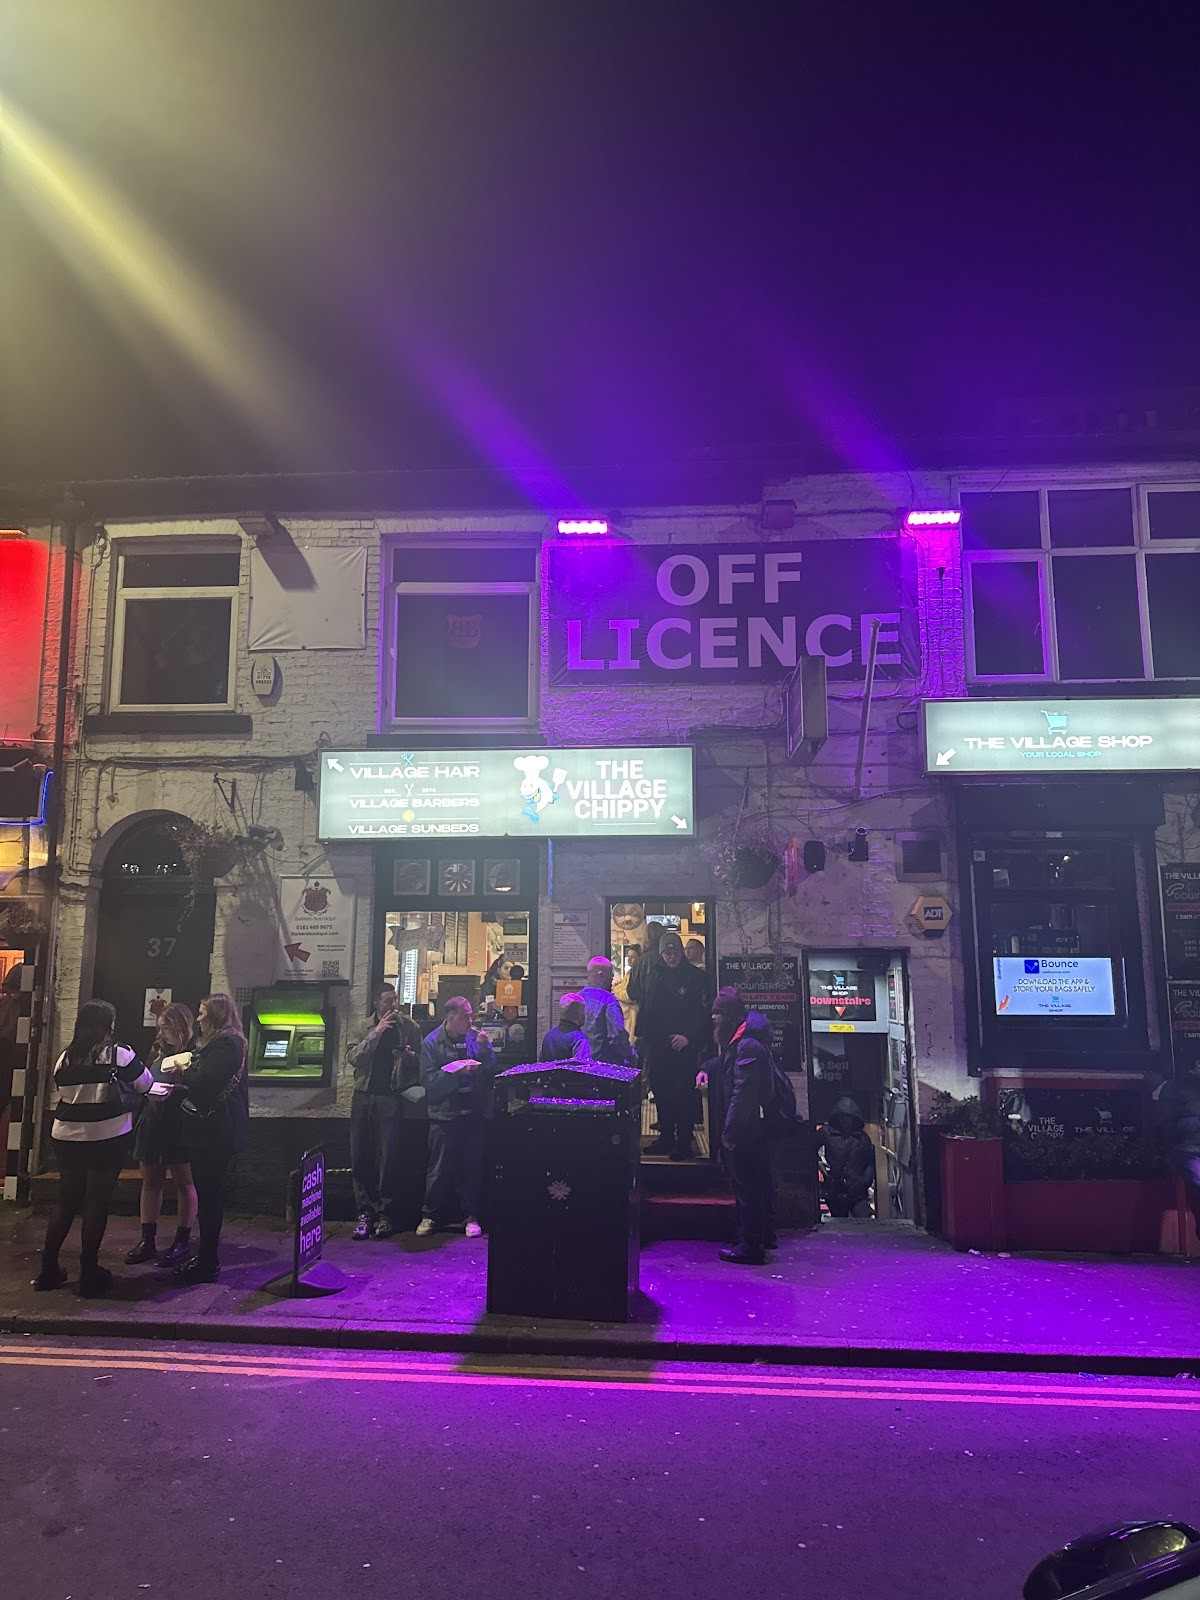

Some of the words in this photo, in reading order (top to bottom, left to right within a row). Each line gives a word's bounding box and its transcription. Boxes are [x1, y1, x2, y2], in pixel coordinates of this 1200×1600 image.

[656, 552, 802, 606] OFF
[567, 612, 902, 670] LICENCE
[964, 737, 1005, 750] THE
[1010, 736, 1093, 749] VILLAGE
[1098, 735, 1153, 748] SHOP
[349, 767, 430, 779] VILLAGE
[434, 766, 480, 778] HAIR
[595, 760, 644, 779] THE
[566, 779, 667, 800] VILLAGE
[348, 799, 409, 808] VILLAGE
[411, 798, 480, 807] BARBERS
[575, 798, 665, 820] CHIPPY
[347, 825, 407, 834] VILLAGE
[411, 824, 479, 833] SUNBEDS
[1164, 872, 1180, 880] THE
[924, 908, 943, 918] ADT
[147, 937, 176, 957] 37
[726, 962, 739, 970] THE
[741, 962, 772, 970] VLLAGE
[1041, 960, 1079, 968] Bounce
[1172, 989, 1188, 997] THE
[810, 996, 871, 1005] Downstairs
[1039, 1117, 1056, 1125] THE
[1027, 1124, 1065, 1132] VILLAGE
[302, 1163, 322, 1193] cash
[299, 1225, 321, 1255] here
